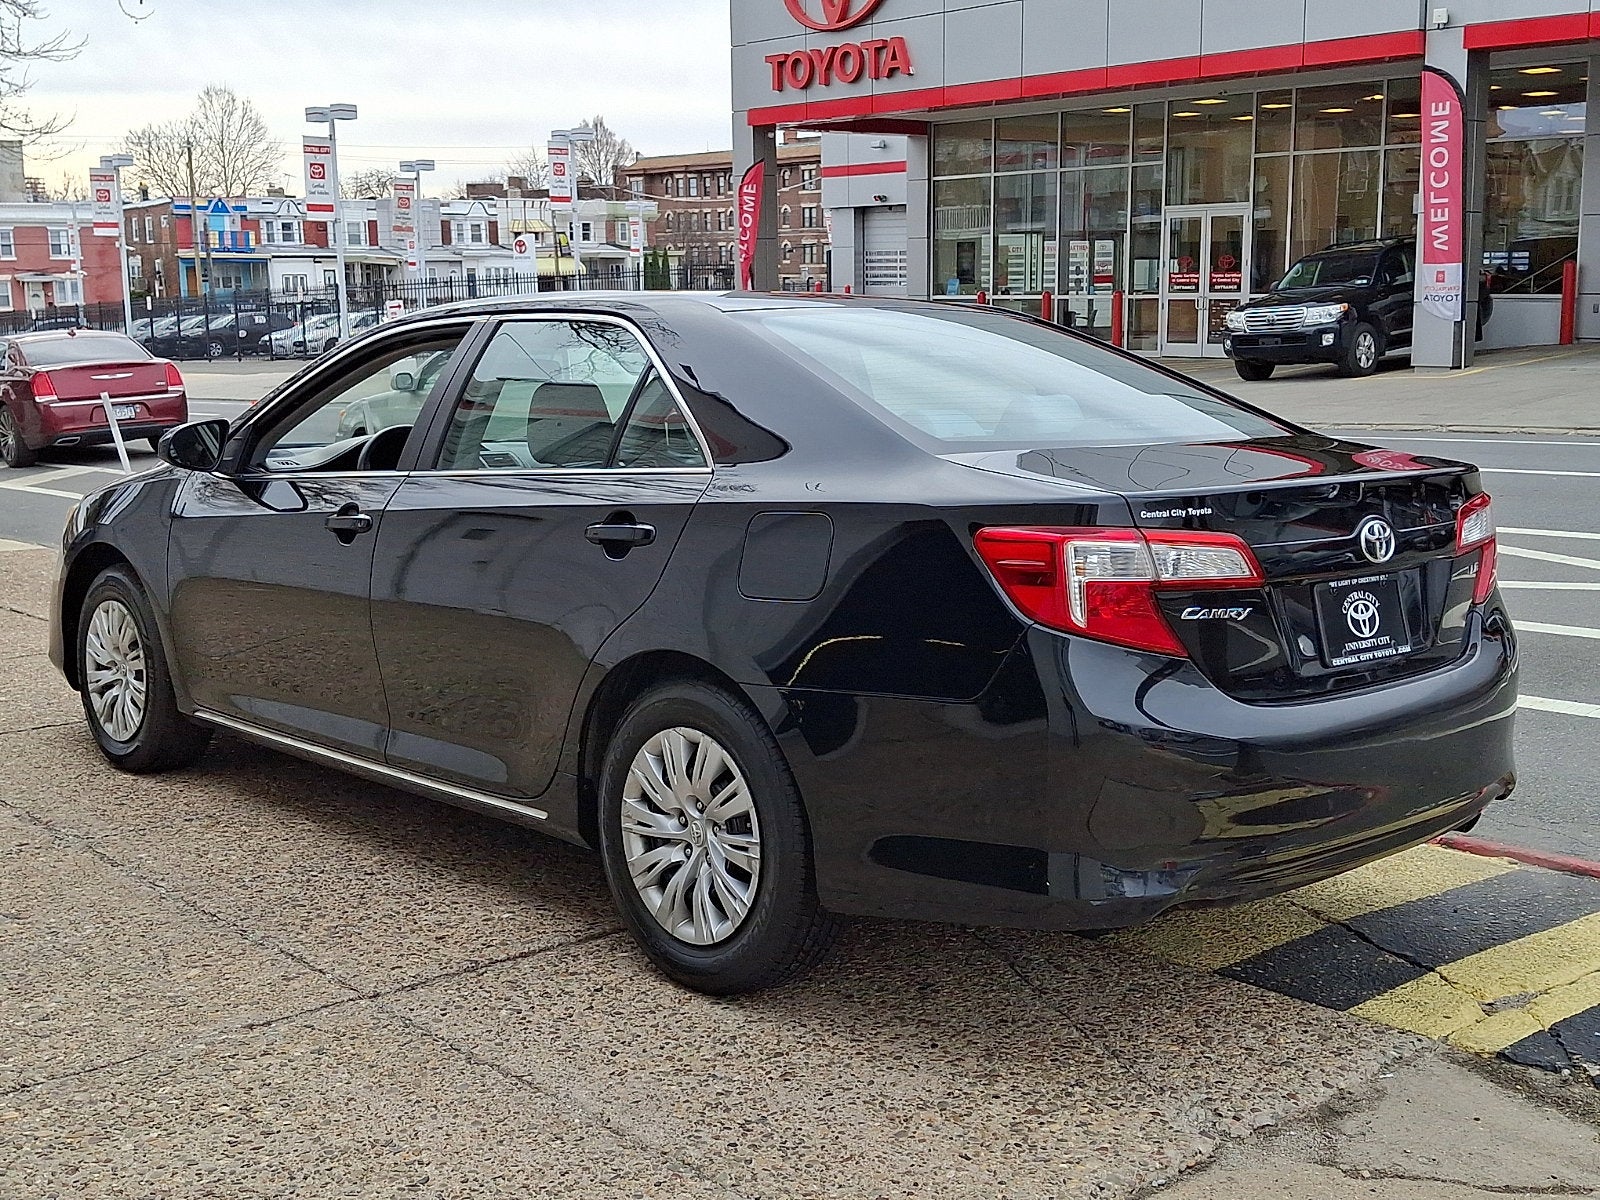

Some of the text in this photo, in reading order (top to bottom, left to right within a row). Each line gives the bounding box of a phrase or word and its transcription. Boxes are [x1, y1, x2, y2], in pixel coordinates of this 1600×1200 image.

[765, 37, 913, 91] TOYOTA
[1140, 507, 1212, 518] Central City Toyota
[1341, 590, 1381, 614] CENTRAL CITY
[1180, 607, 1253, 620] CAMRY
[1345, 636, 1391, 651] UNIVERSITY CITY
[1332, 655, 1360, 665] CENTRAL
[1360, 653, 1374, 661] CITY
[1374, 648, 1397, 658] TOYOTA
